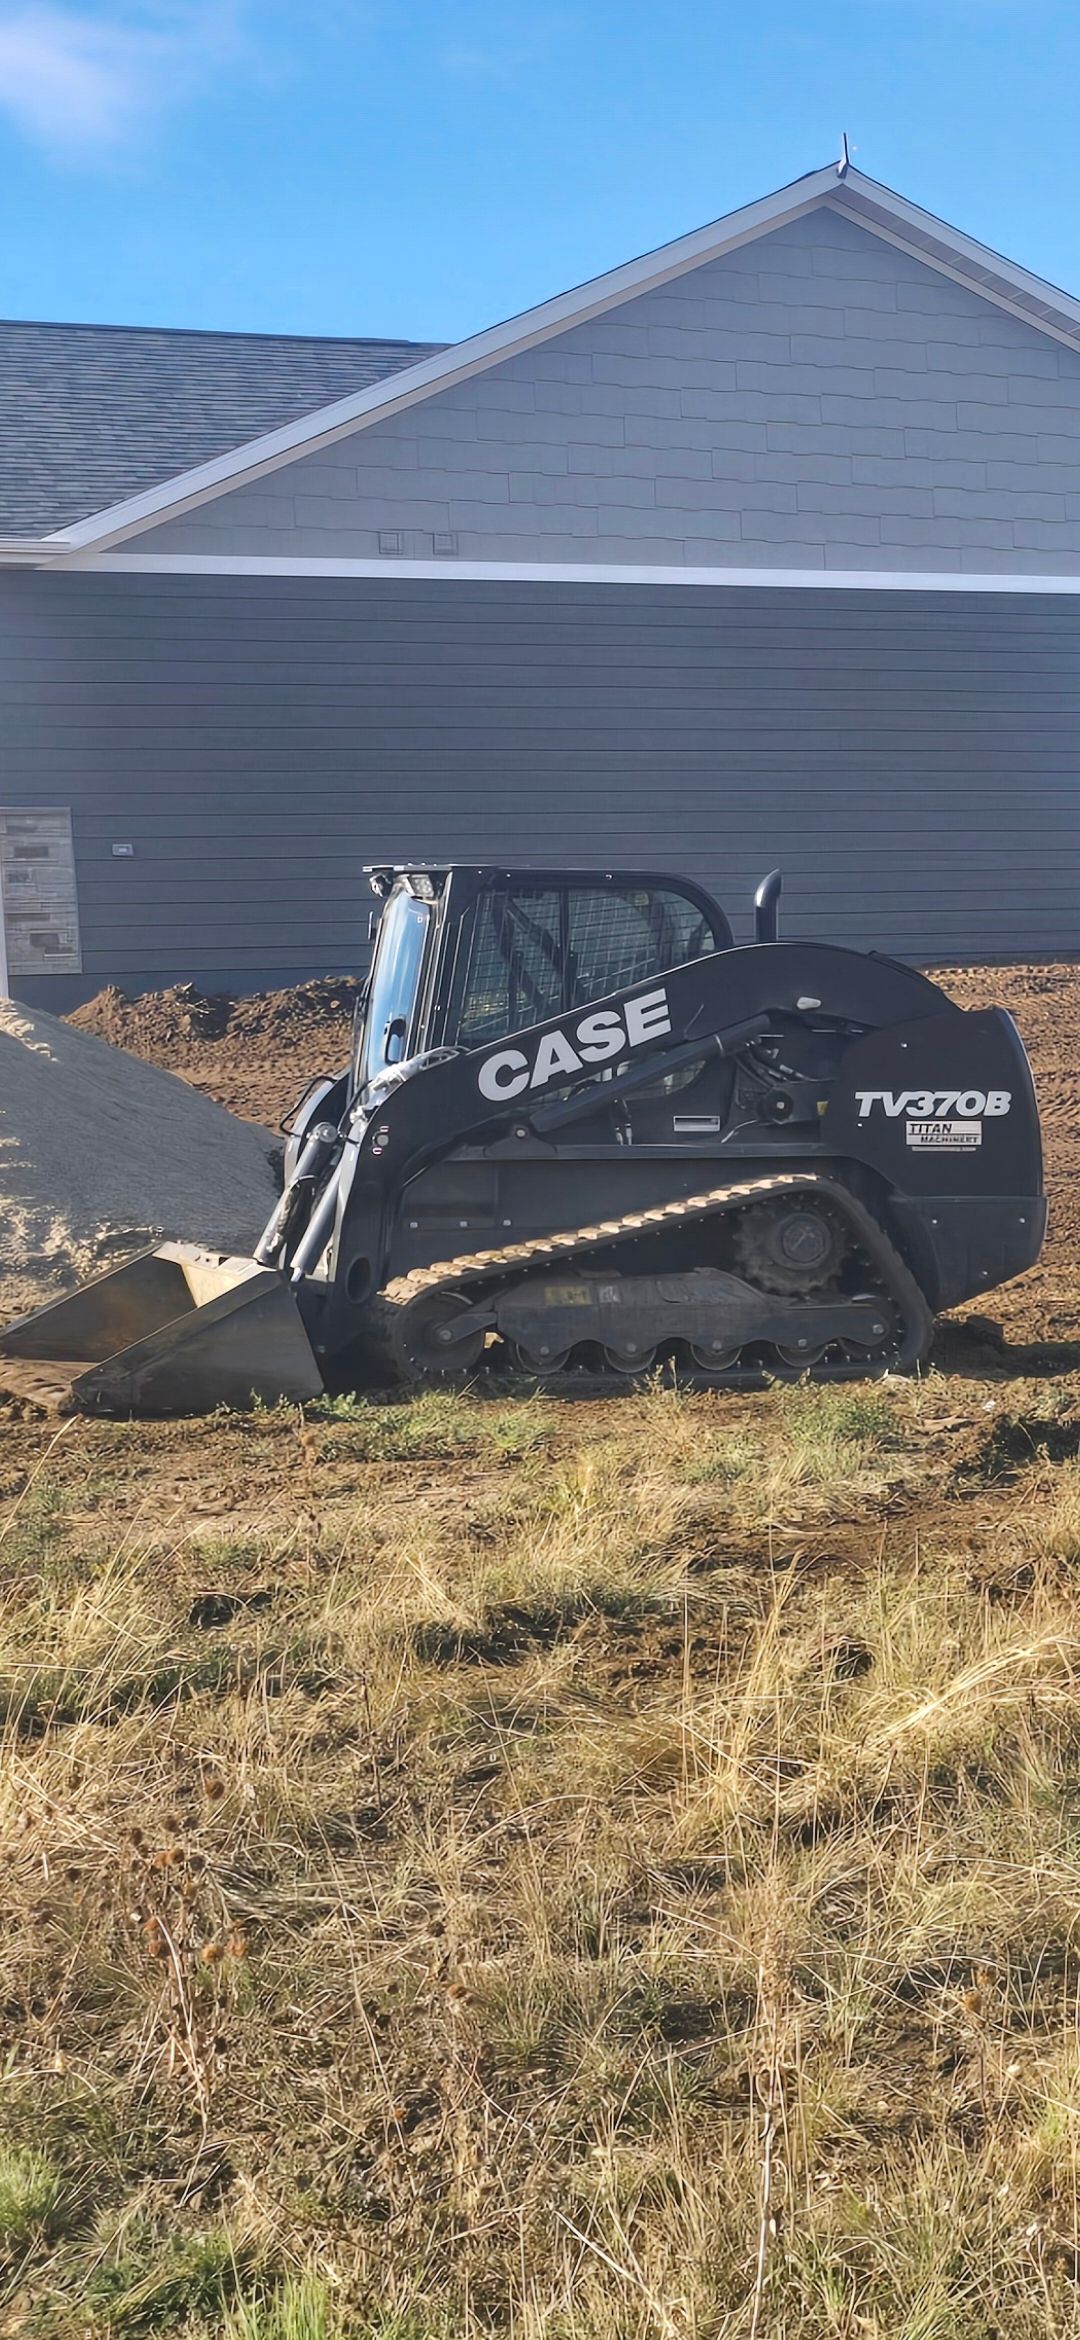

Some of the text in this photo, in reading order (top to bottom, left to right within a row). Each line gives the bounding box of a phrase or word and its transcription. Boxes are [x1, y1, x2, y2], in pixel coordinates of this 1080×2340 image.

[477, 988, 672, 1102] CASE
[855, 1090, 1013, 1118] TV370B
[909, 1123, 953, 1134] TITAN
[920, 1135, 979, 1144] MACHINERY
